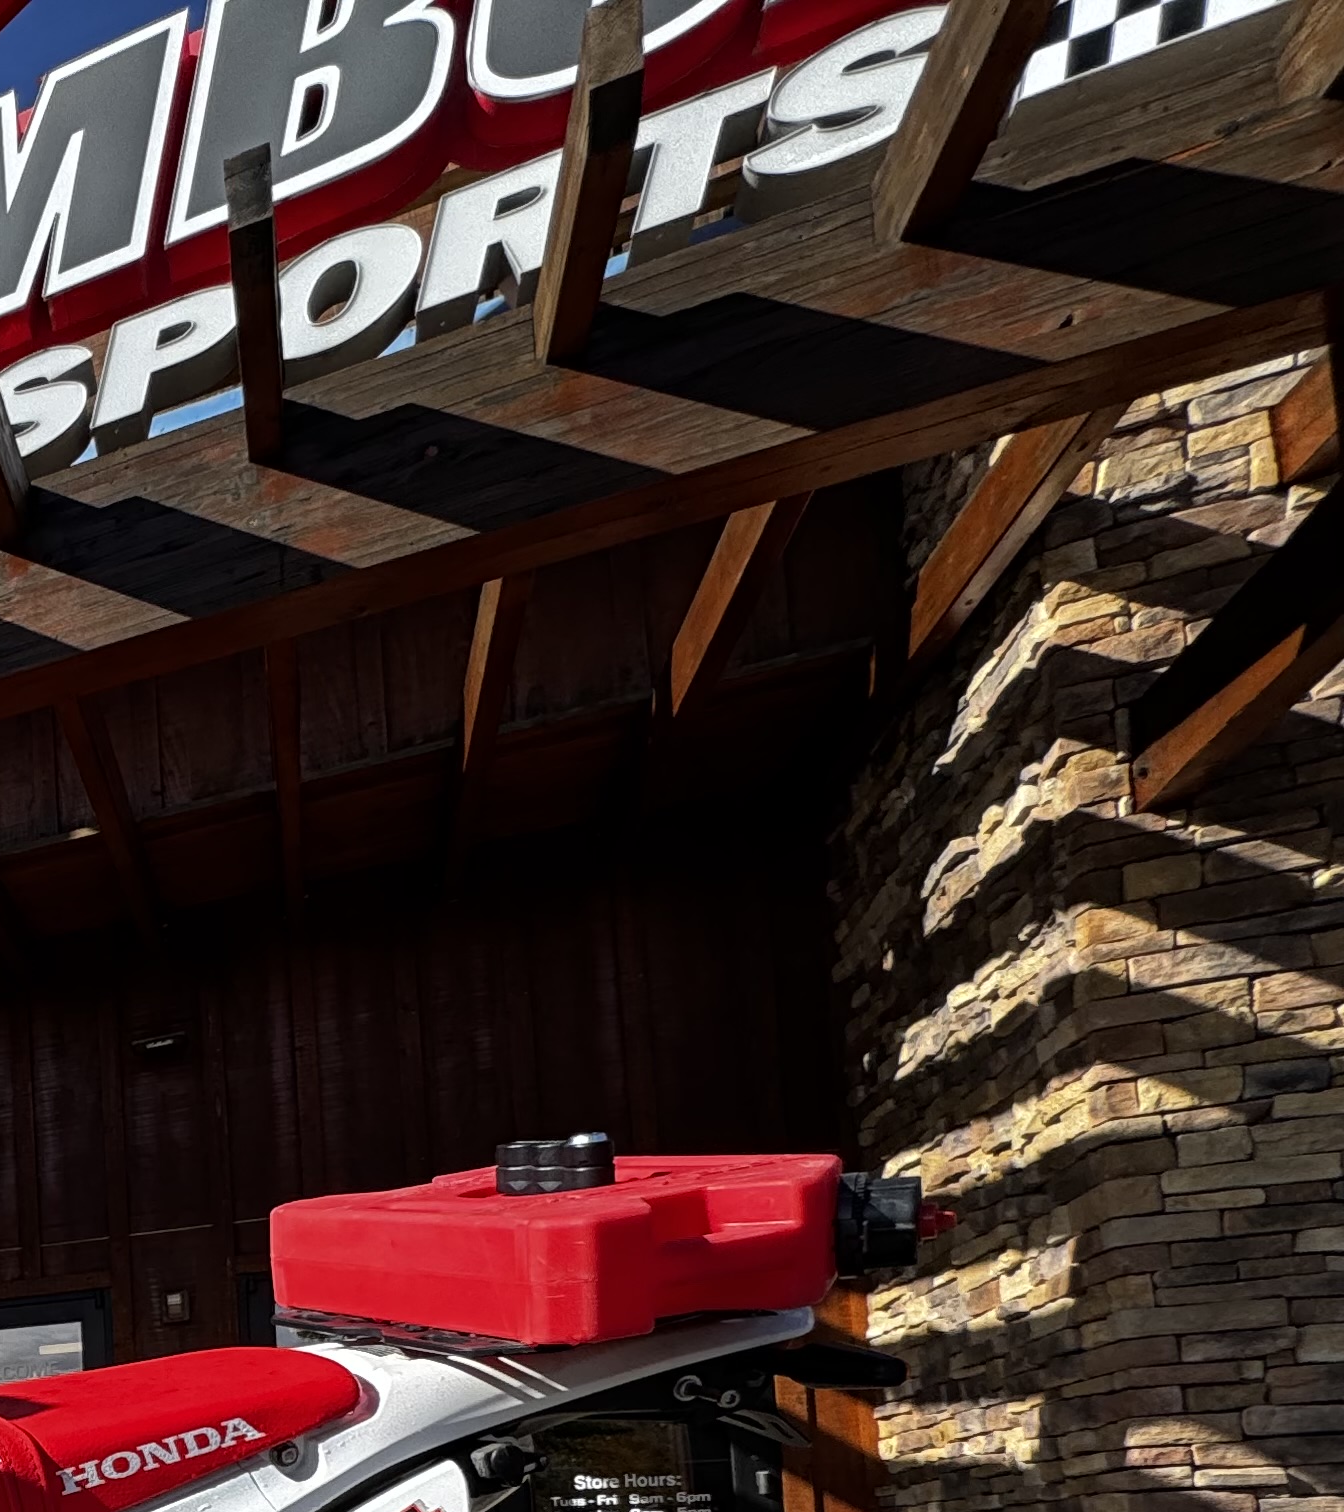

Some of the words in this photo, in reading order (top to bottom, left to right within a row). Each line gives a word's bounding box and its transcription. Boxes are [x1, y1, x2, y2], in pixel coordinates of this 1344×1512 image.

[56, 1417, 267, 1496] HONDA
[573, 1474, 619, 1490] Store
[624, 1473, 682, 1488] Hours:
[550, 1496, 586, 1507] Tues
[597, 1494, 618, 1506] Fri
[628, 1493, 666, 1505] 9am
[676, 1491, 711, 1503] 6pm
